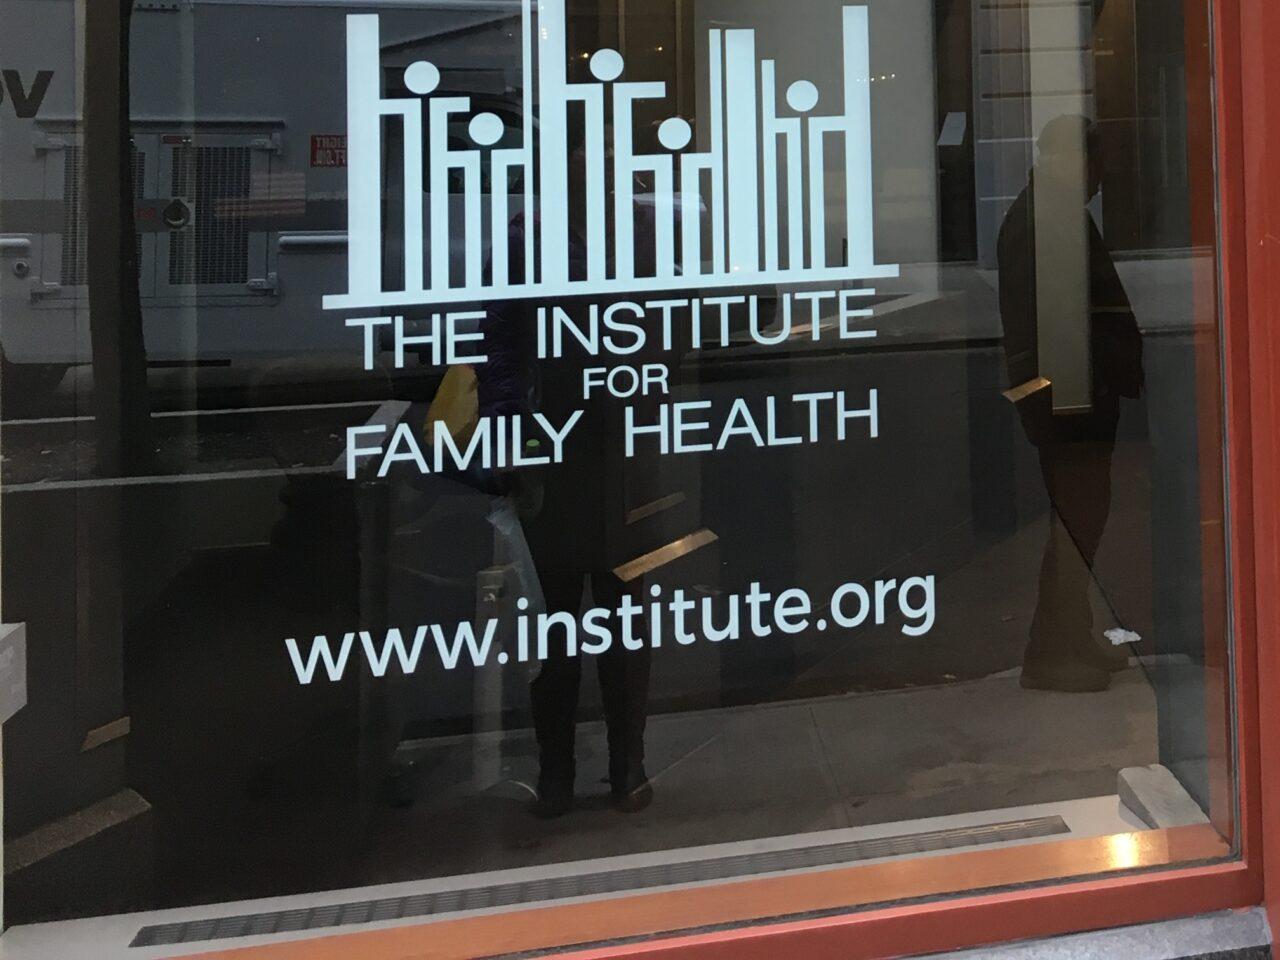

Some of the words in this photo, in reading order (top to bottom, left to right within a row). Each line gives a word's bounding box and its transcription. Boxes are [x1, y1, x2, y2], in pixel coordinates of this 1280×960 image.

[345, 310, 488, 370] THE
[537, 288, 878, 359] INSTITUTE
[583, 363, 670, 400] FOR
[346, 410, 584, 480] FAMILY
[625, 388, 879, 457] HEALTH
[285, 574, 936, 686] www.institute.org
